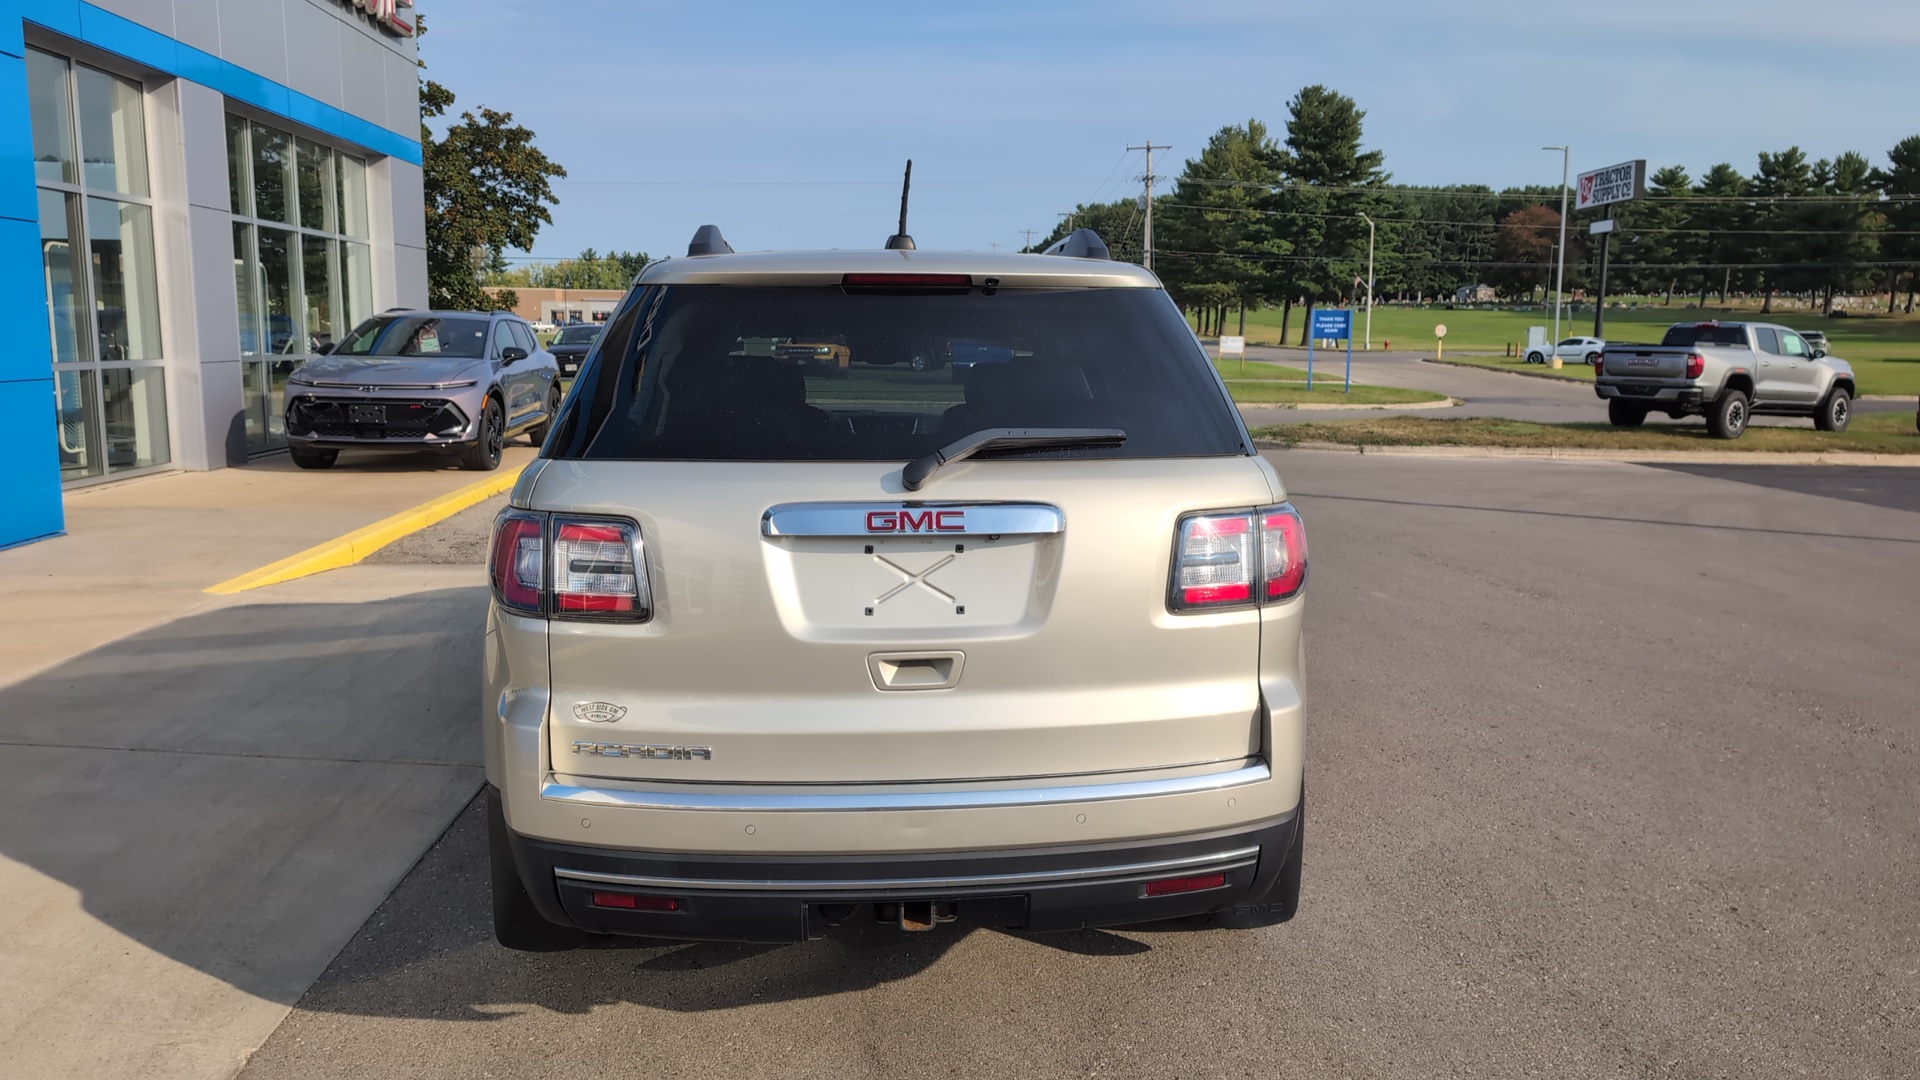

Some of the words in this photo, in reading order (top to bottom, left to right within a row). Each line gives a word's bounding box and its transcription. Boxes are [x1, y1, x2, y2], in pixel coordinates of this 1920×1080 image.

[1594, 165, 1632, 187] TRACTOR
[1592, 183, 1622, 204] SUPPLY
[865, 510, 966, 533] GMC
[580, 704, 596, 713] WEST
[596, 703, 609, 712] SIDE
[609, 706, 620, 715] GM
[571, 740, 713, 760] ACADIA
[1233, 902, 1284, 915] GMC
